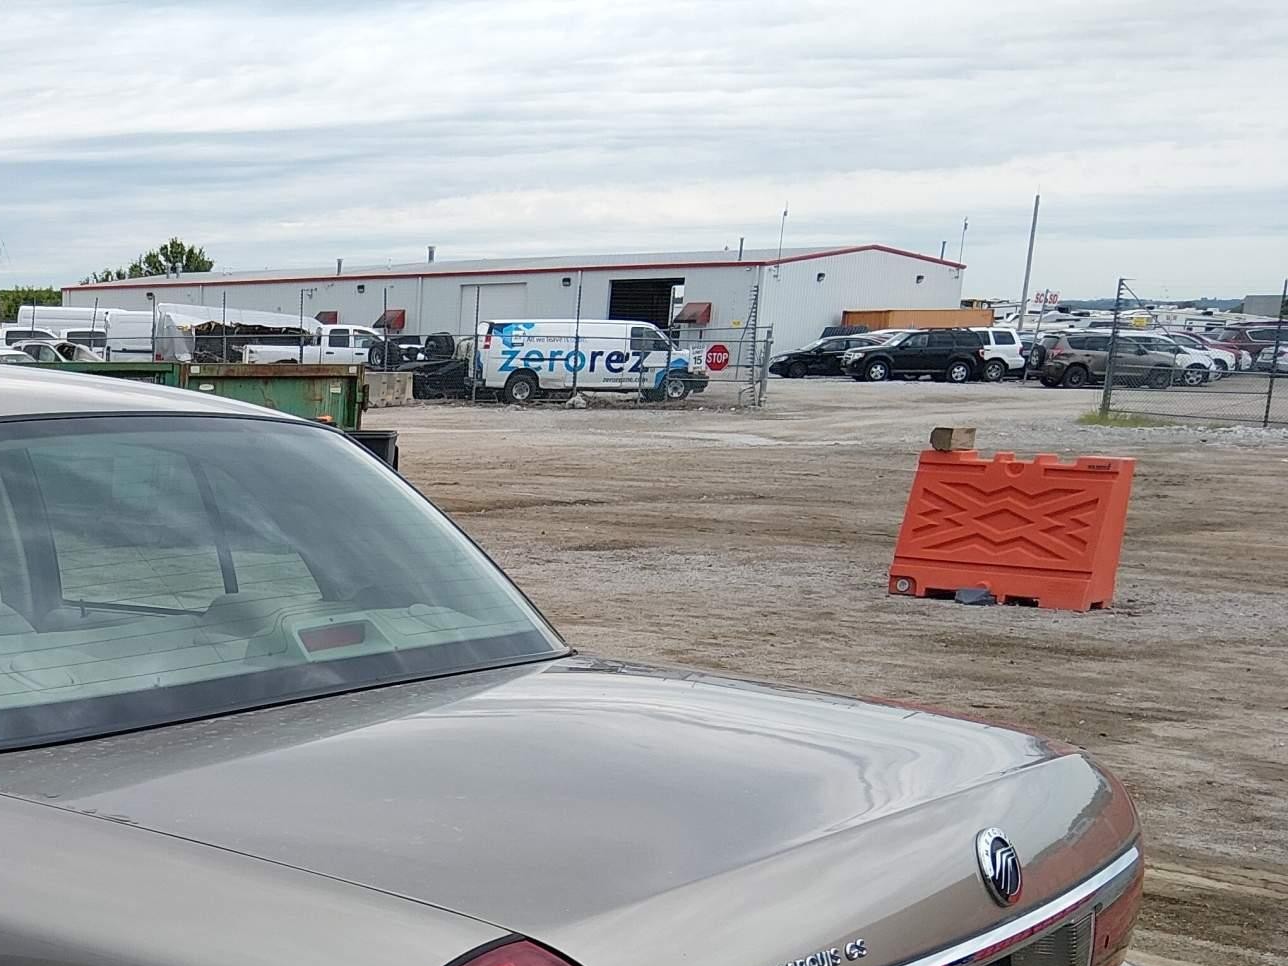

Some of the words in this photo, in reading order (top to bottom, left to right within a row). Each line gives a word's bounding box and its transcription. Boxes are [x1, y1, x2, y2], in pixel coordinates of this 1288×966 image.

[498, 349, 651, 373] zerorez
[693, 355, 703, 365] 15
[707, 352, 729, 364] STOP
[845, 938, 868, 961] GS
